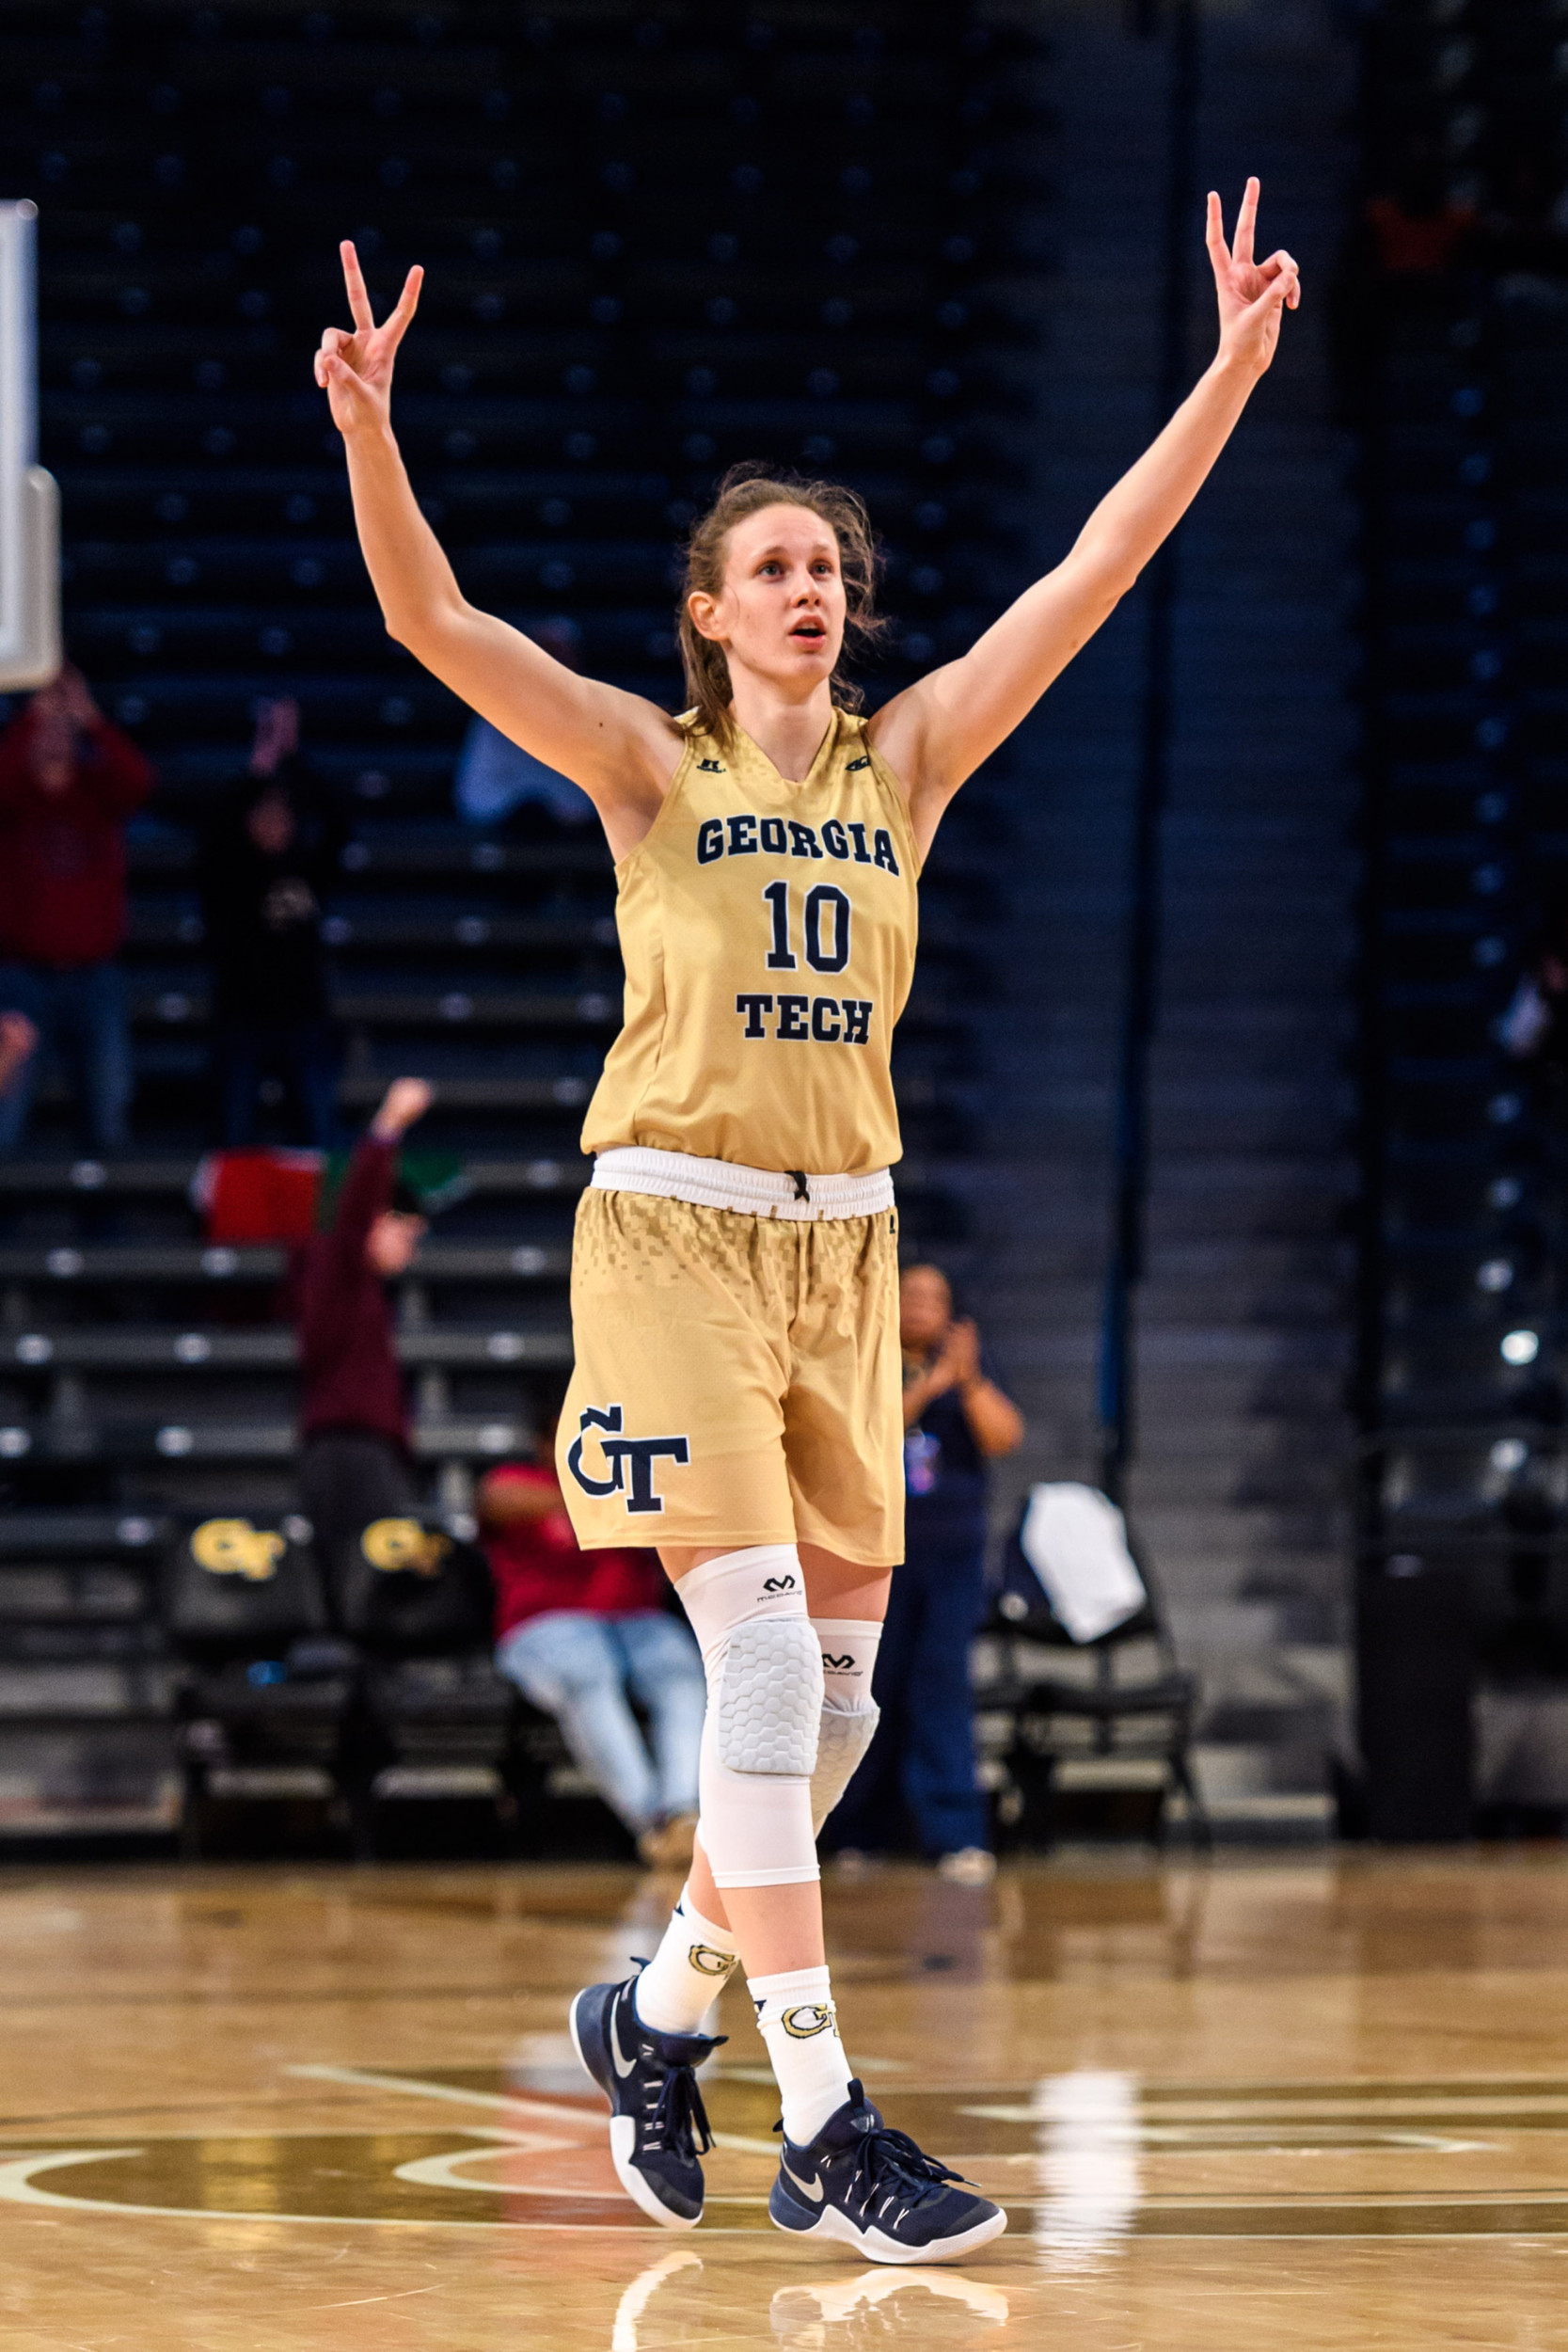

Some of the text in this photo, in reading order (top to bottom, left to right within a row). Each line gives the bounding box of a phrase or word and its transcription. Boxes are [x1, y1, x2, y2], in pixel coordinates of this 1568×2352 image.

[696, 815, 900, 877] GEORGIA
[762, 880, 851, 974] 10
[736, 993, 873, 1044] TECH
